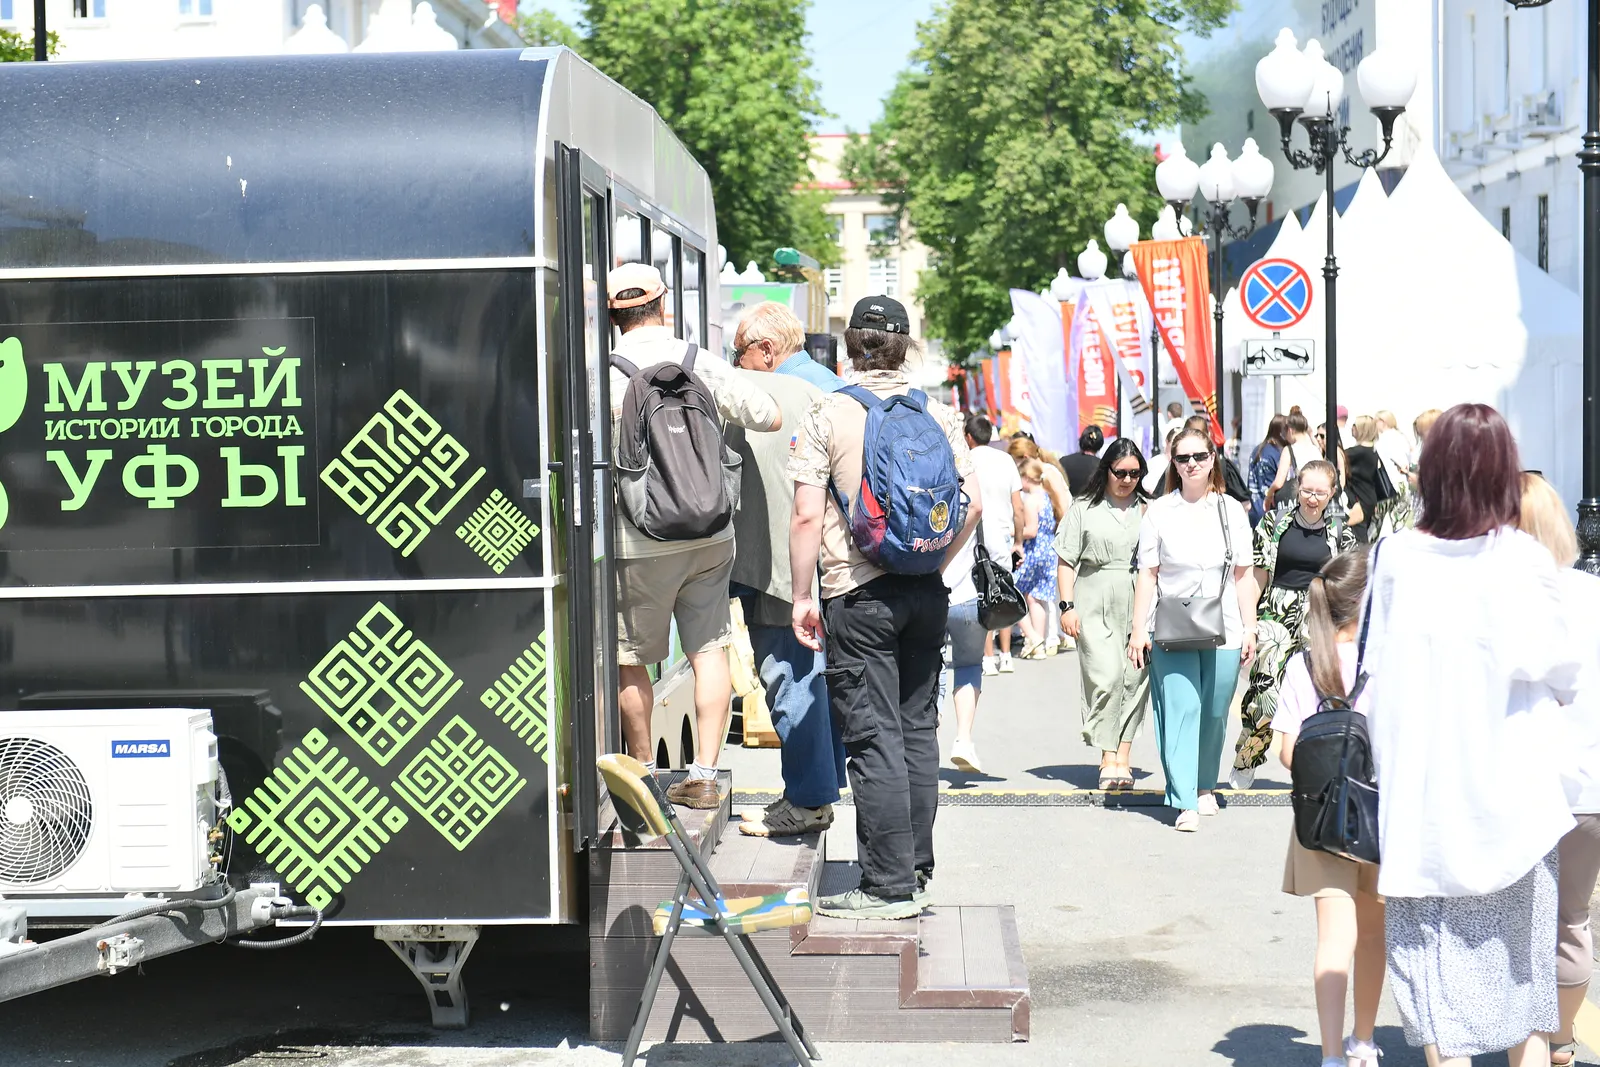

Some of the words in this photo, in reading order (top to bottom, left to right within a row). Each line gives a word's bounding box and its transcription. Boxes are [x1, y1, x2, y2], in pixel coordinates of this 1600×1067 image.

[42, 345, 303, 413] МУЗЕЙ
[44, 416, 181, 442] ИСТОРИИ
[190, 414, 304, 440] ГОРОДА
[46, 443, 307, 512] УФЫ
[114, 743, 168, 755] MARSA
